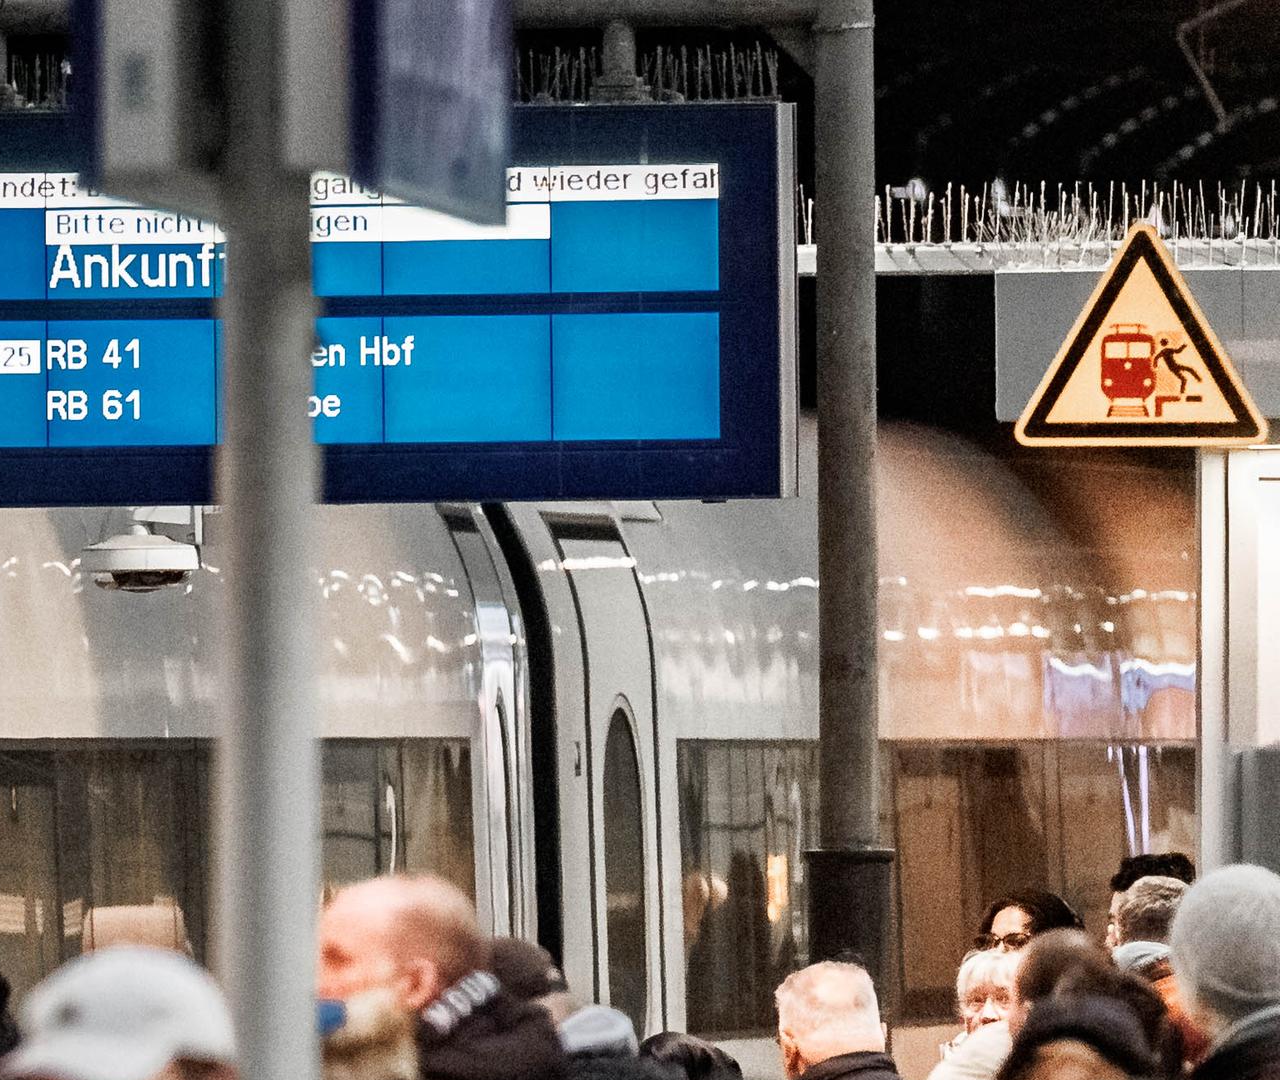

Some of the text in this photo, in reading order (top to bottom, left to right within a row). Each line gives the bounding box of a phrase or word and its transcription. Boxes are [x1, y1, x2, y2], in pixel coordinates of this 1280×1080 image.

[532, 170, 633, 192] wieder
[56, 213, 125, 235] Bitte
[49, 242, 226, 289] Ankunf
[46, 339, 89, 370] RB
[101, 338, 141, 369] 41
[359, 335, 415, 366] Hbf
[46, 389, 89, 421] RB
[101, 389, 141, 421] 61
